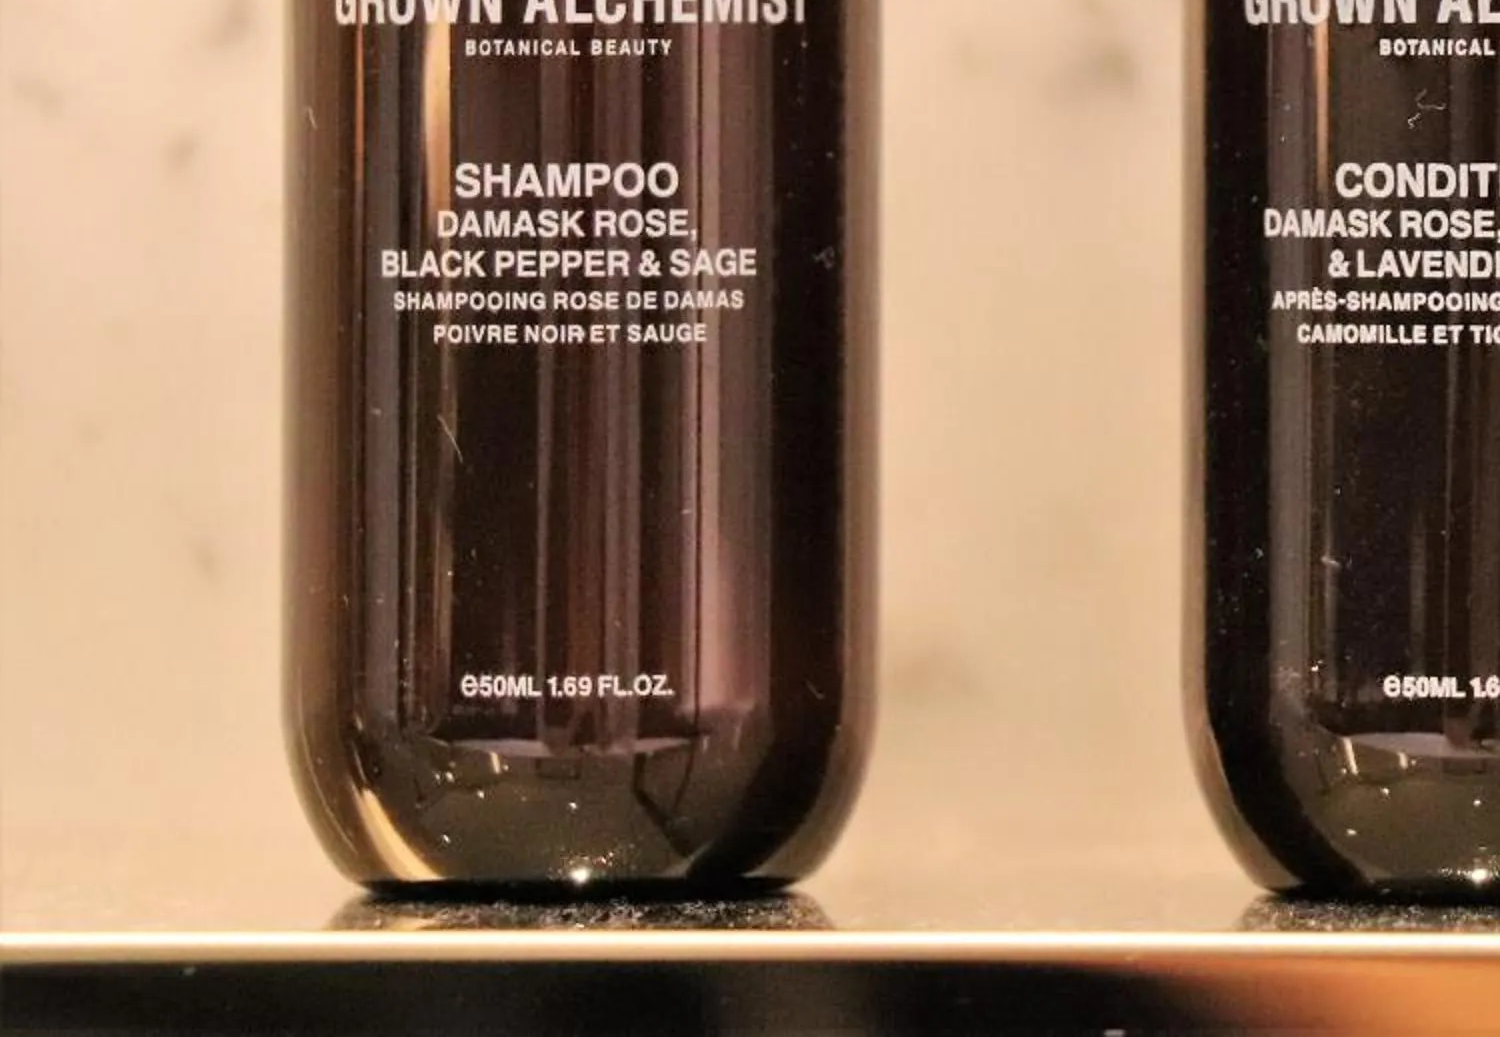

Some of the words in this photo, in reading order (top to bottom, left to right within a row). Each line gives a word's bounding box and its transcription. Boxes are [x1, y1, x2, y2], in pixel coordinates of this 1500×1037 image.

[464, 39, 581, 56] BOTANICAL
[591, 39, 672, 56] BEAUTY
[1379, 38, 1495, 56] BOTANICAL
[454, 162, 679, 198] SHAMPOO
[437, 210, 585, 238] DAMASK
[594, 209, 697, 241] ROSE,
[1263, 208, 1393, 238] DAMASK
[381, 250, 486, 278] BLACK
[494, 250, 630, 277] PEPPER
[639, 250, 661, 277] &
[669, 249, 757, 277] SAGE
[1328, 251, 1350, 278] &
[393, 291, 546, 310] SHAMPOOING
[553, 291, 619, 310] ROSE
[626, 292, 656, 309] DE
[664, 290, 744, 309] DAMAS
[433, 325, 517, 343] POIVRE
[524, 325, 584, 343] NOIR
[591, 325, 619, 342] ET
[627, 324, 707, 342] SAUGE
[1297, 325, 1426, 344] CAMOMILLE
[1433, 325, 1463, 343] ET
[547, 676, 592, 697] 1.69
[598, 674, 675, 697] FL.OZ.
